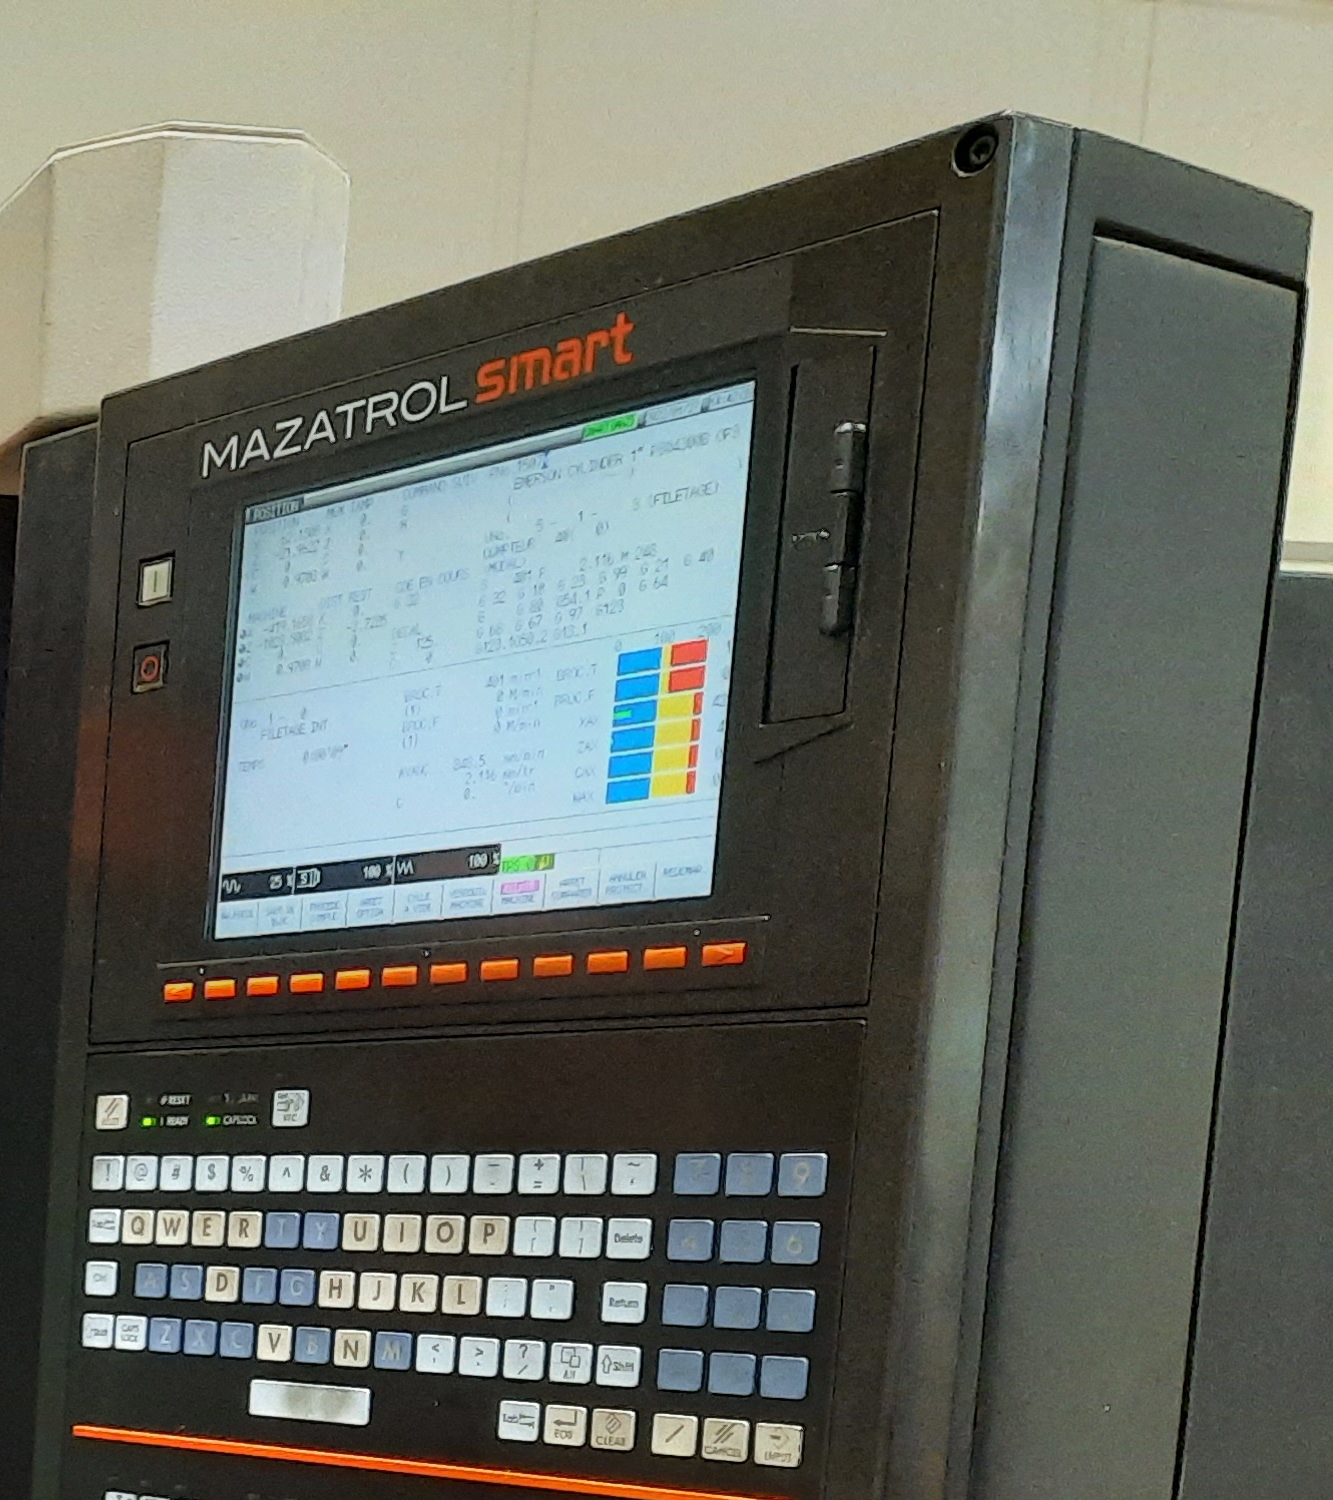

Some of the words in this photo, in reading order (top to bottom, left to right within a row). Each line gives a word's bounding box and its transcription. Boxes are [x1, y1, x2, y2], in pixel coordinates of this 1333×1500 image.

[201, 376, 468, 479] MAZATROL
[476, 311, 634, 404] smart
[207, 1163, 217, 1180] $
[238, 1164, 254, 1182] %
[319, 1164, 331, 1183] &
[163, 1217, 181, 1237] W
[202, 1217, 212, 1237] E
[238, 1217, 250, 1239] R
[354, 1220, 367, 1242] U
[436, 1221, 454, 1243] O
[483, 1222, 495, 1245] P
[614, 1232, 644, 1245] Delete
[216, 1272, 229, 1292] D
[328, 1278, 343, 1299] H
[371, 1279, 382, 1302] J
[411, 1281, 426, 1304] K
[457, 1283, 467, 1306] L
[608, 1296, 640, 1309] Return
[160, 1326, 172, 1345] Z
[193, 1328, 206, 1348] X
[267, 1331, 282, 1354] V
[342, 1338, 359, 1362] N
[382, 1340, 403, 1360] M
